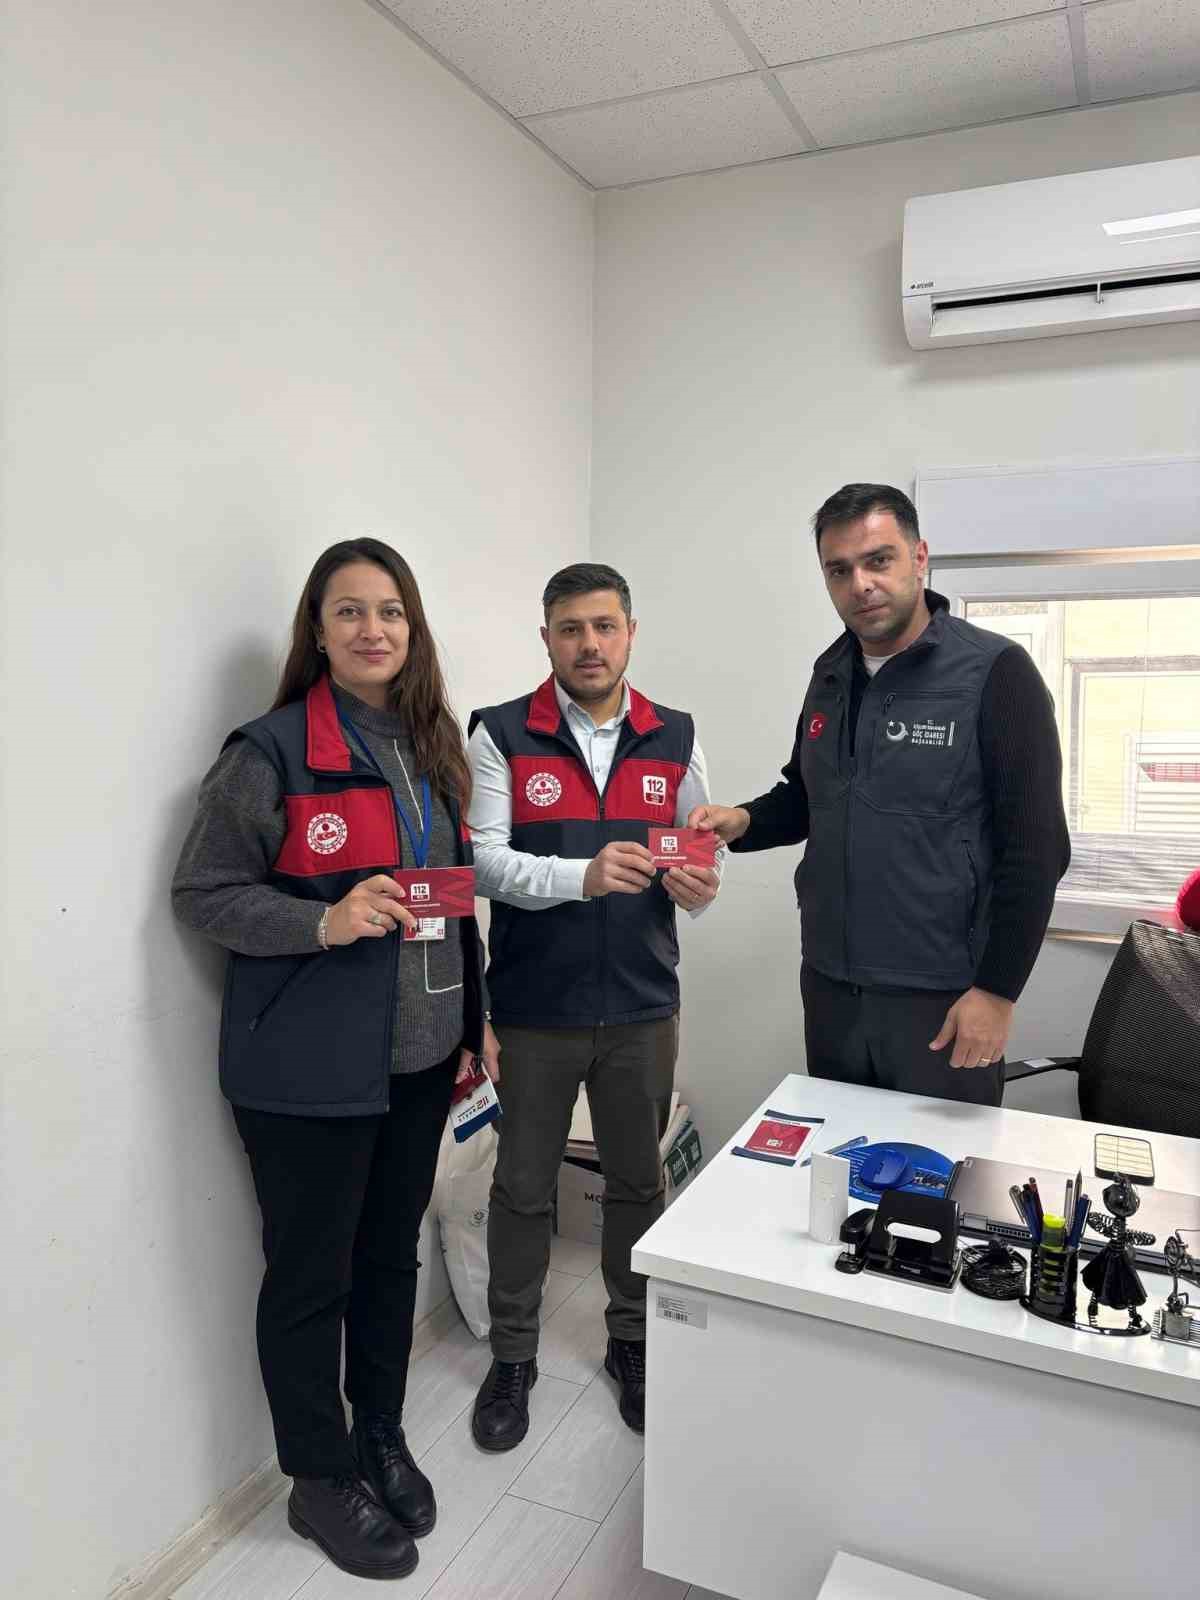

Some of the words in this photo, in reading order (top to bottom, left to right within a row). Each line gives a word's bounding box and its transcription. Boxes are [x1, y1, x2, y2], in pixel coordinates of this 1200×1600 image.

[647, 779, 664, 793] 112
[664, 838, 675, 846] 112
[413, 886, 427, 894] 112
